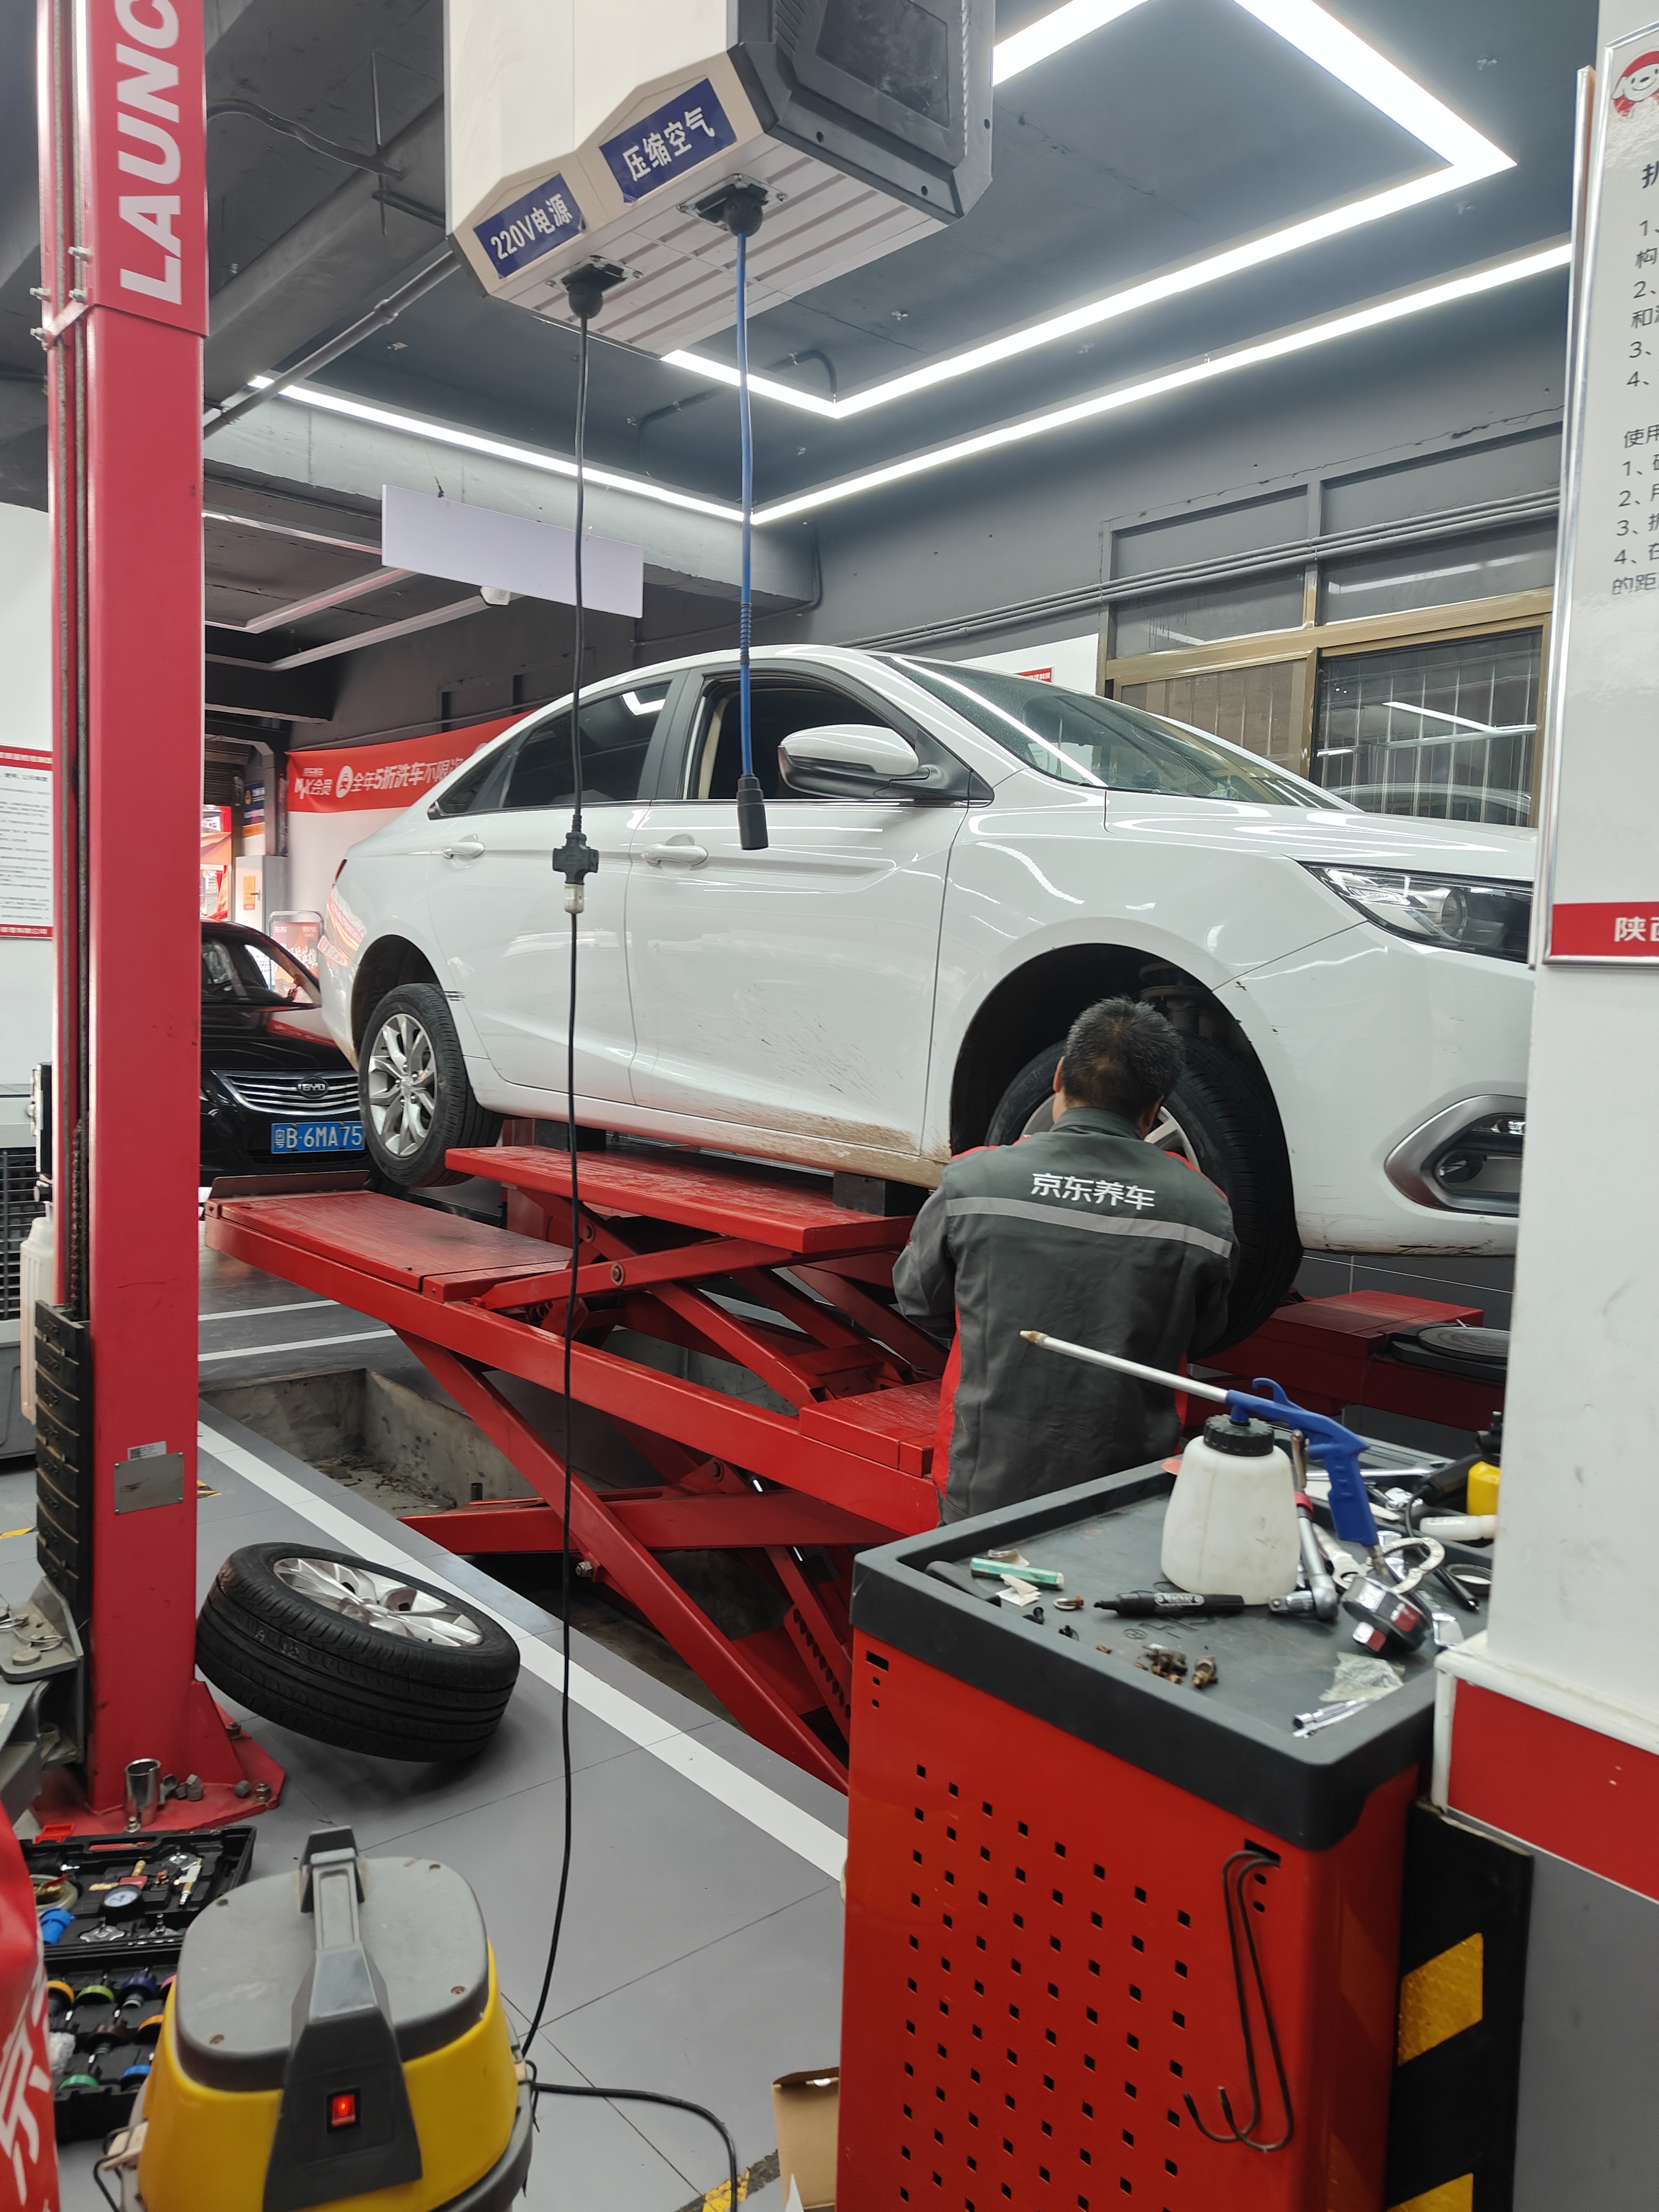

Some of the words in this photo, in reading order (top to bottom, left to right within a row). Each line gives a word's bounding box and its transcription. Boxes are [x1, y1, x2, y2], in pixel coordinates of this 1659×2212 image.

[623, 107, 716, 181] 压缩空气
[490, 193, 573, 260] 220V电源
[1633, 281, 1656, 298] 2、
[1631, 305, 1659, 328] 和
[1629, 341, 1651, 358] 3、
[1627, 371, 1649, 386] 4、
[1624, 424, 1659, 448] 使用
[302, 1082, 326, 1091] BYD
[1031, 1173, 1156, 1210] 京东养车
